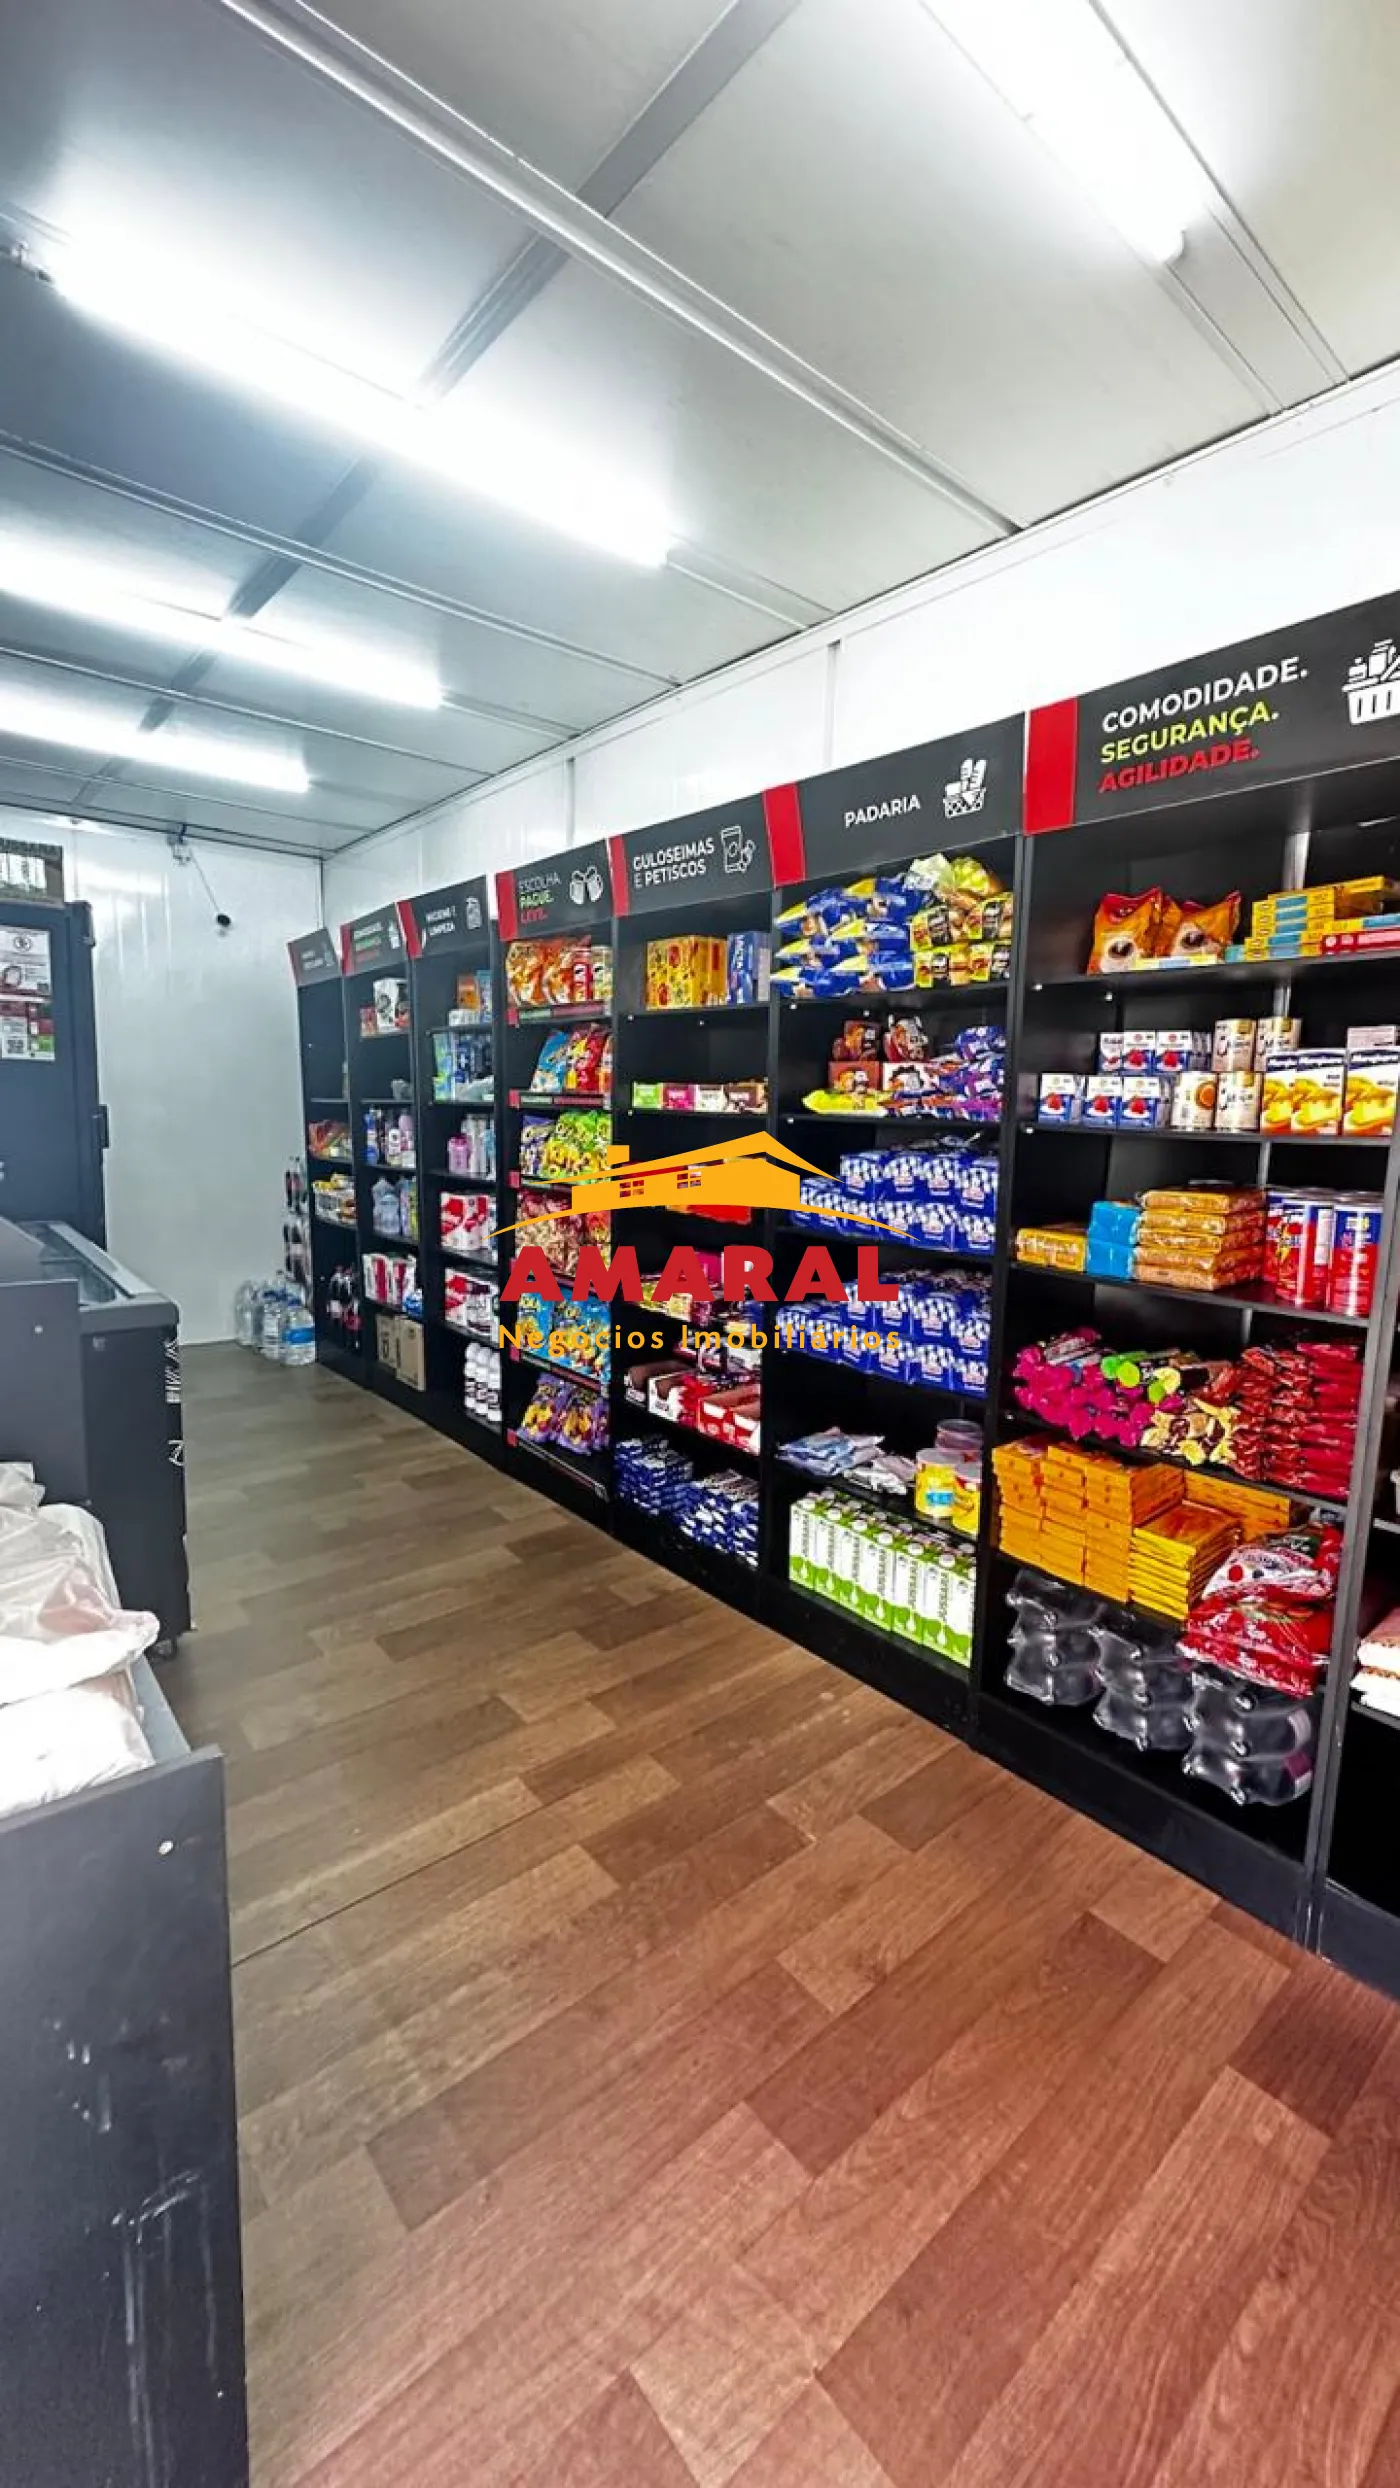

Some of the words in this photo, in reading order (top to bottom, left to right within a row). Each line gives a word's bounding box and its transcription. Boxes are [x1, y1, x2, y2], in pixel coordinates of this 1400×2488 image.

[1102, 656, 1308, 734] COMODIDADE.
[1100, 701, 1279, 764] SEGURANÇA.
[1098, 738, 1260, 793] AGILIDADE.
[844, 794, 921, 830] PADARIA
[633, 837, 715, 871] GULOSEIMAS
[634, 871, 643, 889] E
[645, 858, 707, 887] PETISCOS
